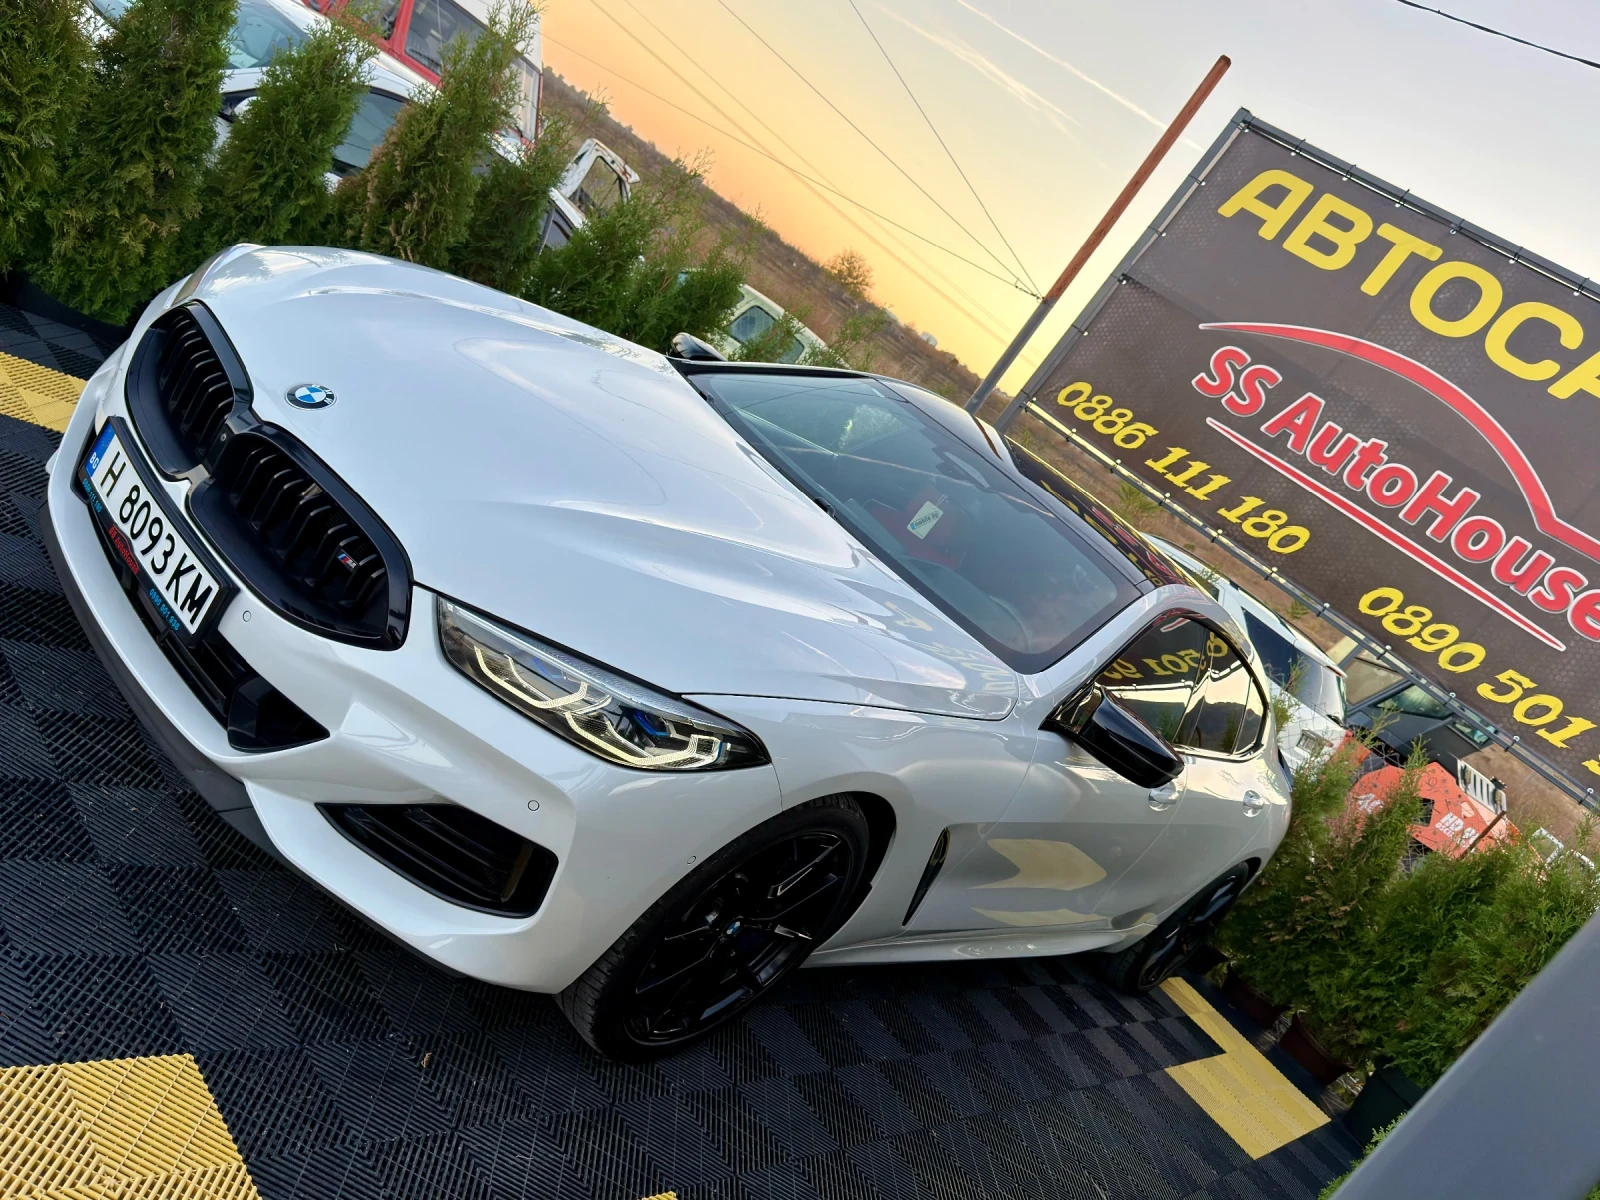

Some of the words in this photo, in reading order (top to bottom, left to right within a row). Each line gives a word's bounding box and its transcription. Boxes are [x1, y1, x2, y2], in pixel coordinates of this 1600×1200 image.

[89, 451, 100, 469] BG
[100, 451, 126, 498] H
[119, 484, 176, 575] 8093
[165, 552, 213, 625] KM
[1057, 381, 1158, 449] 0886
[1144, 446, 1231, 501] 111
[1217, 494, 1311, 555] 180
[1192, 346, 1279, 416] SS
[1263, 393, 1600, 642] AutoHouse
[1358, 586, 1487, 674] 0890
[1476, 668, 1596, 749] 501
